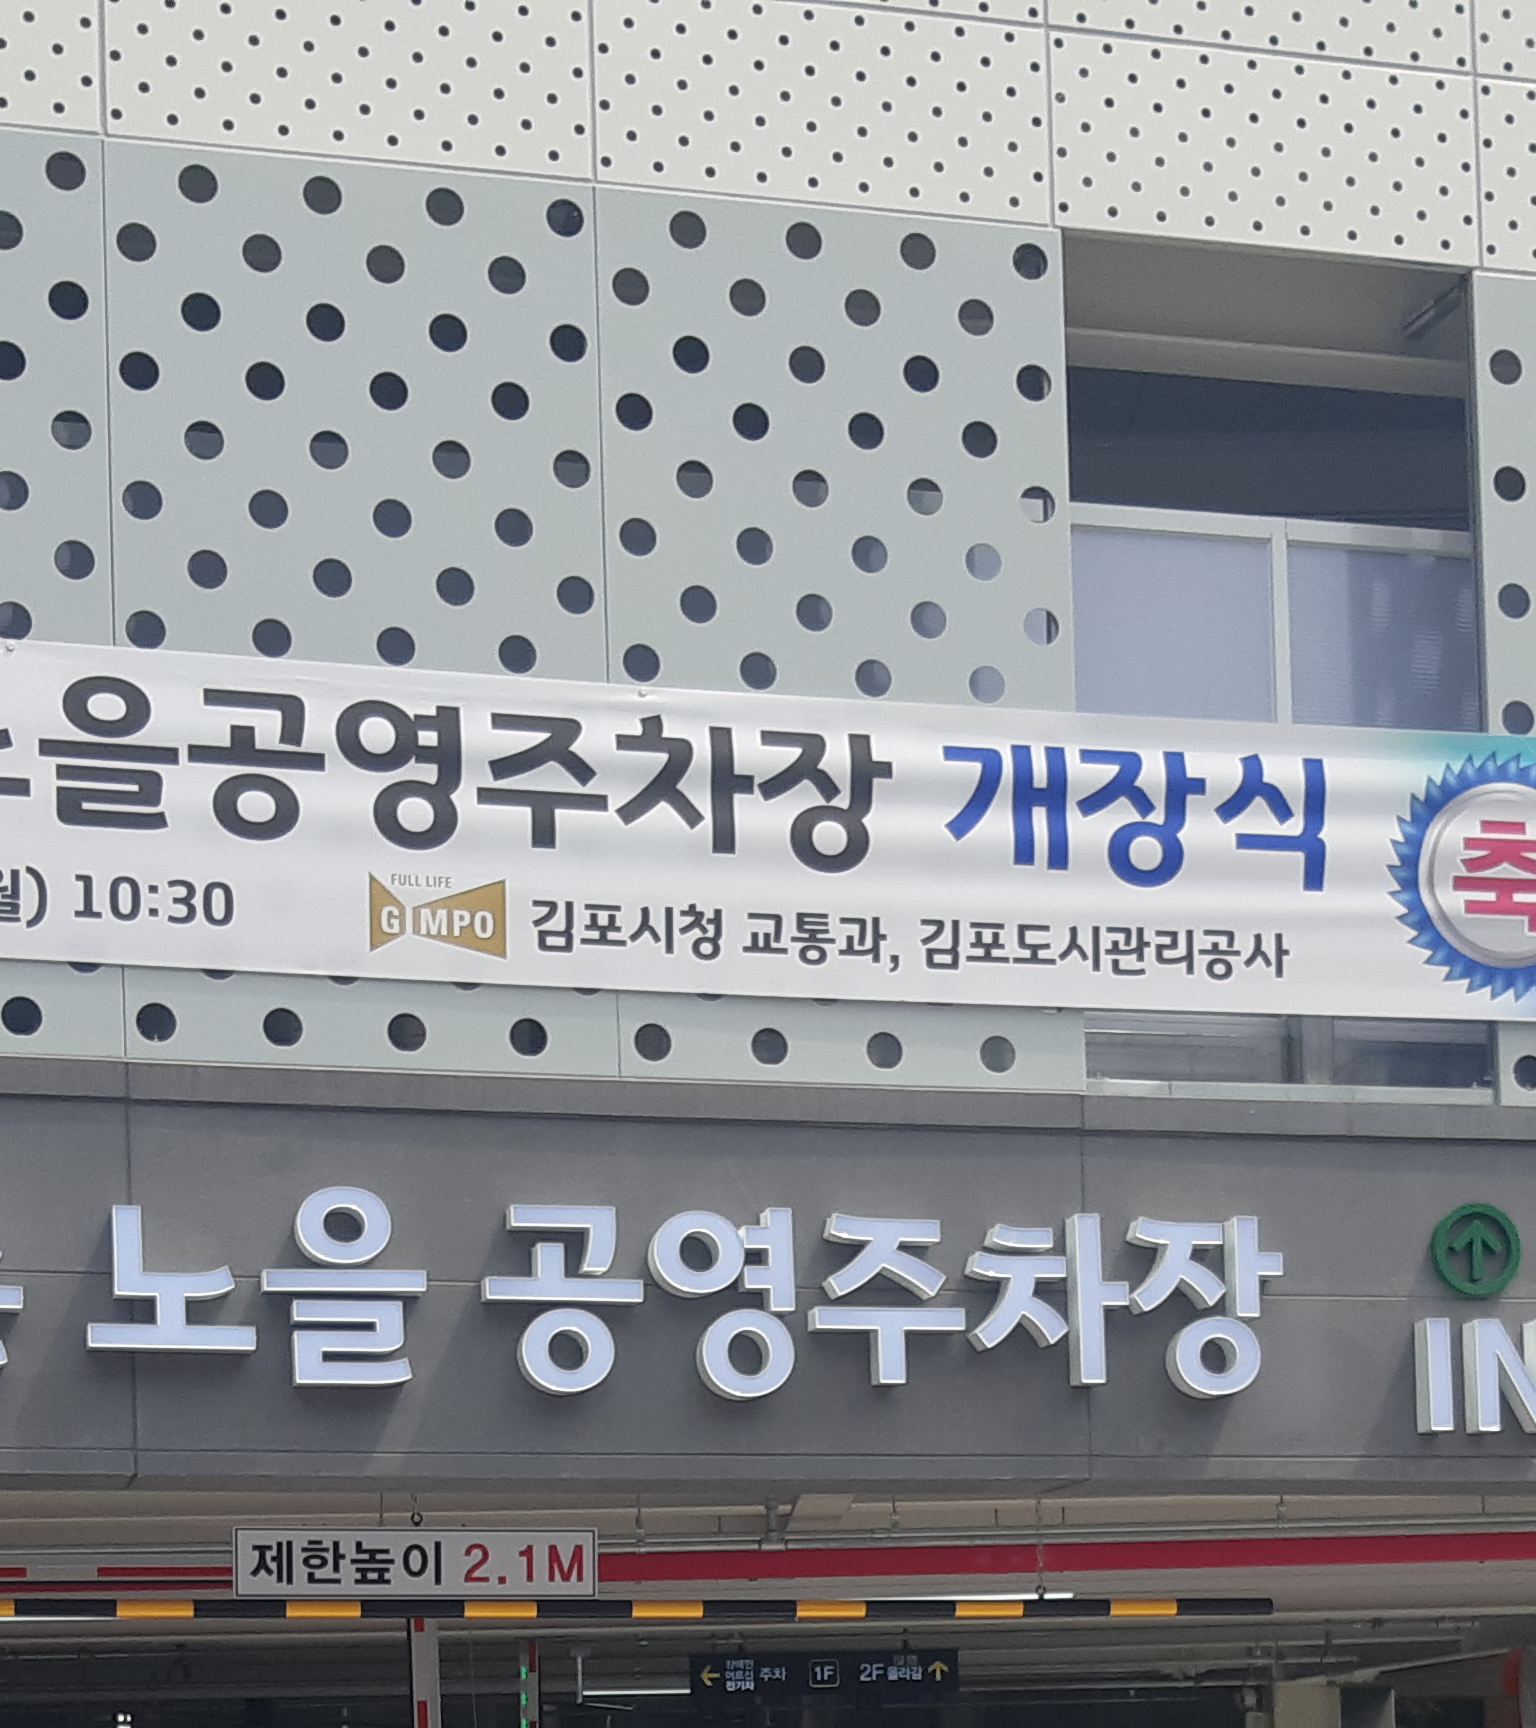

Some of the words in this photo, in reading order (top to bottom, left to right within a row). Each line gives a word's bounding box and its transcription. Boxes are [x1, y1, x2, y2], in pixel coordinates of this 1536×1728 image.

[942, 743, 1327, 892] 개장식
[73, 873, 235, 927] 10:30
[390, 873, 422, 888] FULL
[426, 875, 452, 889] LIFE
[531, 899, 724, 961] 김포시청
[741, 911, 901, 973] 교통과,
[919, 918, 1291, 980] 김포도시관리공사
[86, 1186, 429, 1387] 노을
[483, 1204, 1284, 1400] 공영주차장
[250, 1536, 445, 1590] 제한높이
[463, 1544, 586, 1584] 2.1M
[759, 1667, 787, 1682] 주차
[814, 1666, 835, 1681] 1F
[859, 1664, 884, 1682] 2F
